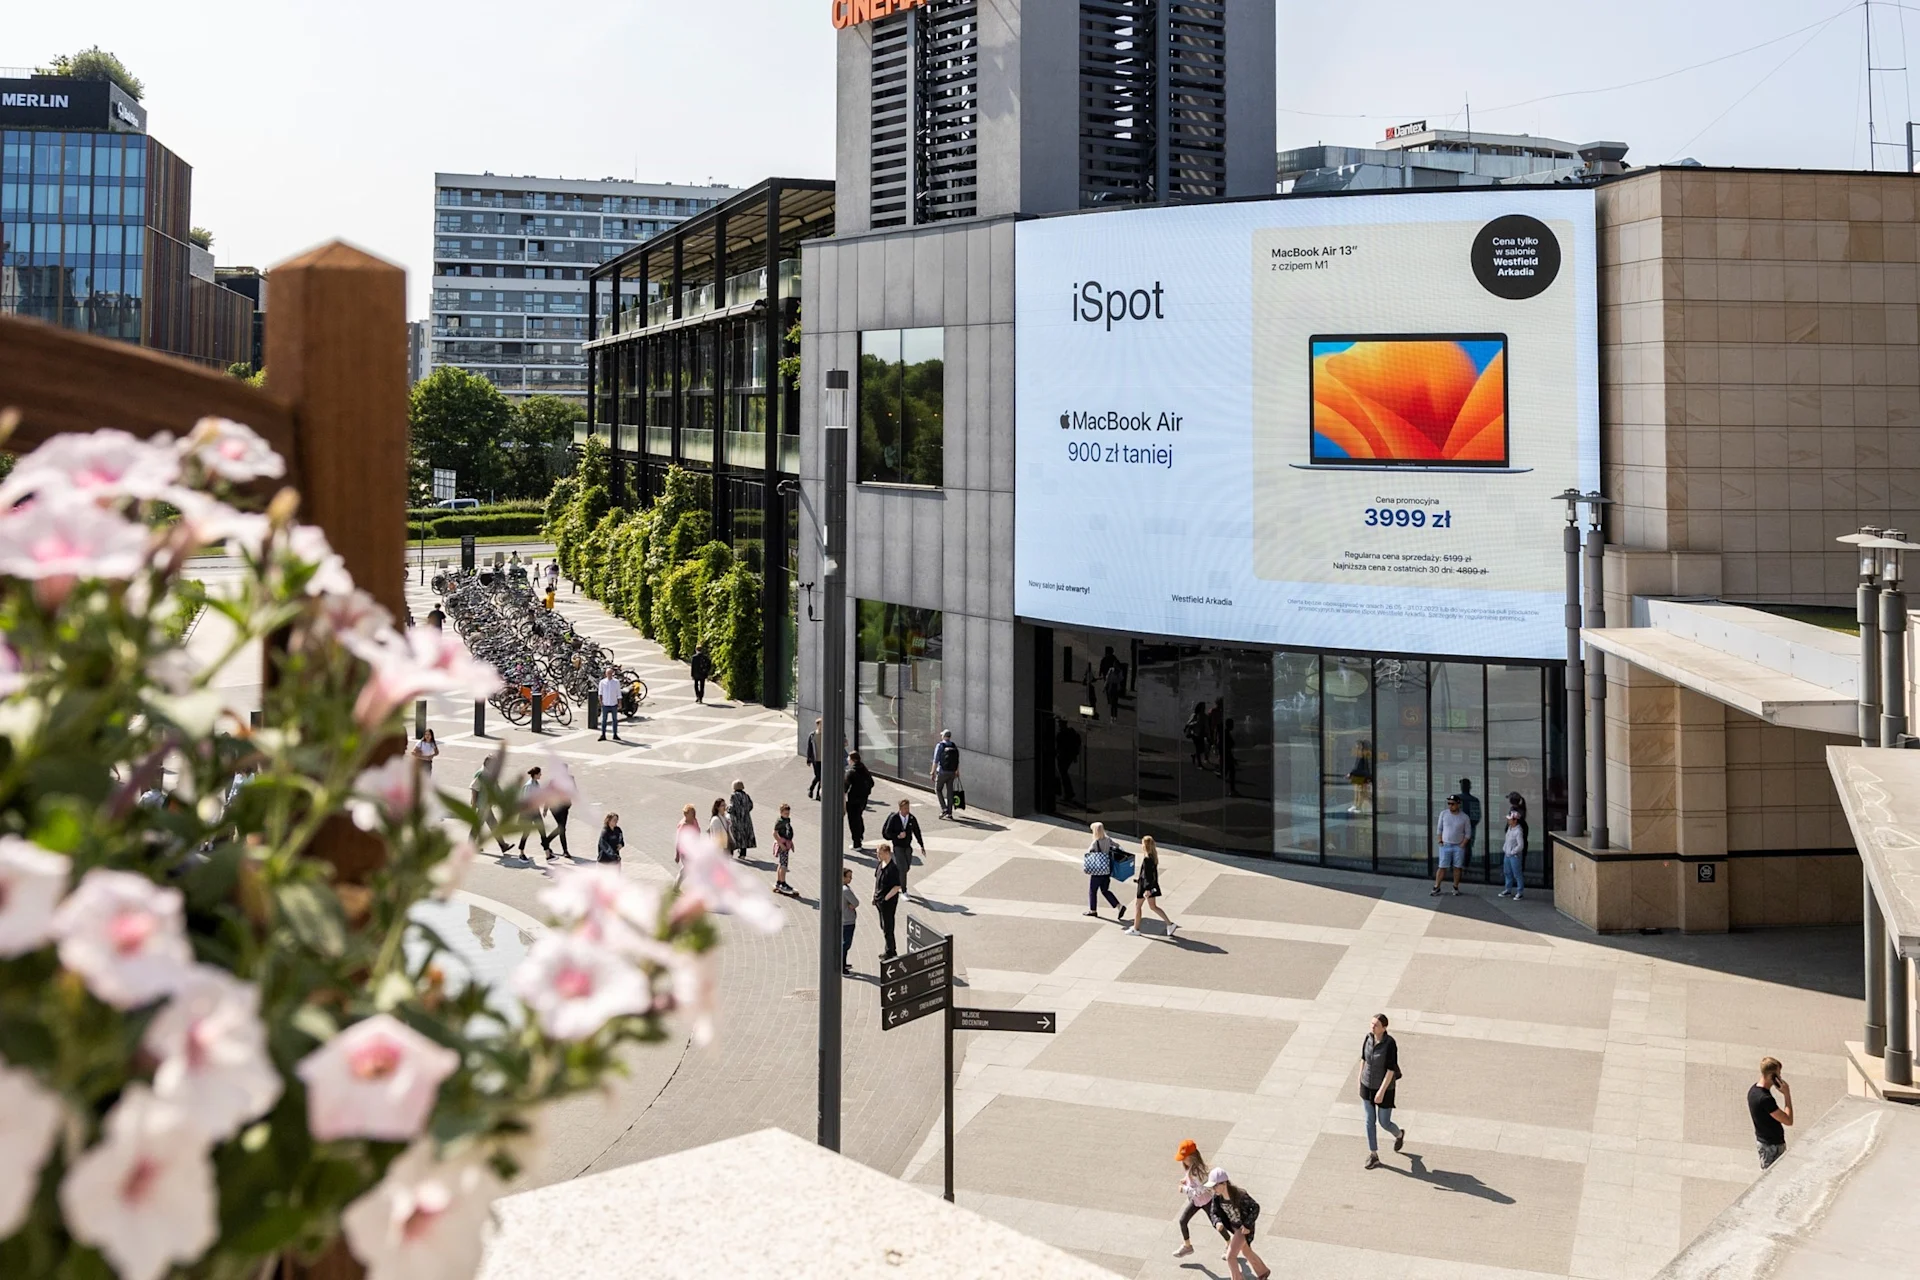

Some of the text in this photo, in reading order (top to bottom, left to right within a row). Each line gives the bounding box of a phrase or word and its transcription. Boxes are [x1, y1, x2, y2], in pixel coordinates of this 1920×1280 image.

[832, 0, 926, 29] CINE
[2, 93, 69, 108] MERLIN
[1395, 123, 1424, 137] Dantex
[1492, 237, 1539, 247] Cena tylko
[1271, 246, 1320, 258] MacBook
[1322, 246, 1337, 256] Air
[1505, 247, 1536, 256] salonie
[1278, 261, 1312, 272] czipem
[1315, 260, 1328, 269] M1
[1493, 257, 1539, 266] Westfield
[1497, 268, 1535, 276] Arkadia
[1073, 280, 1164, 332] iSpot
[1073, 411, 1183, 432] MacBook Air
[1068, 442, 1173, 469] 900 zł taniej
[1396, 497, 1439, 506] promocyjna
[1364, 508, 1452, 528] 3999 zł
[1344, 551, 1381, 560] Regularna
[1401, 553, 1442, 563] sprzedaży:
[1333, 562, 1367, 571] Najniższa
[1393, 565, 1428, 573] ostatnich
[1029, 580, 1041, 589] Nowy
[1056, 582, 1064, 591] już
[1065, 585, 1090, 595] otwarty!
[1172, 594, 1233, 606] Westfield Arkadia
